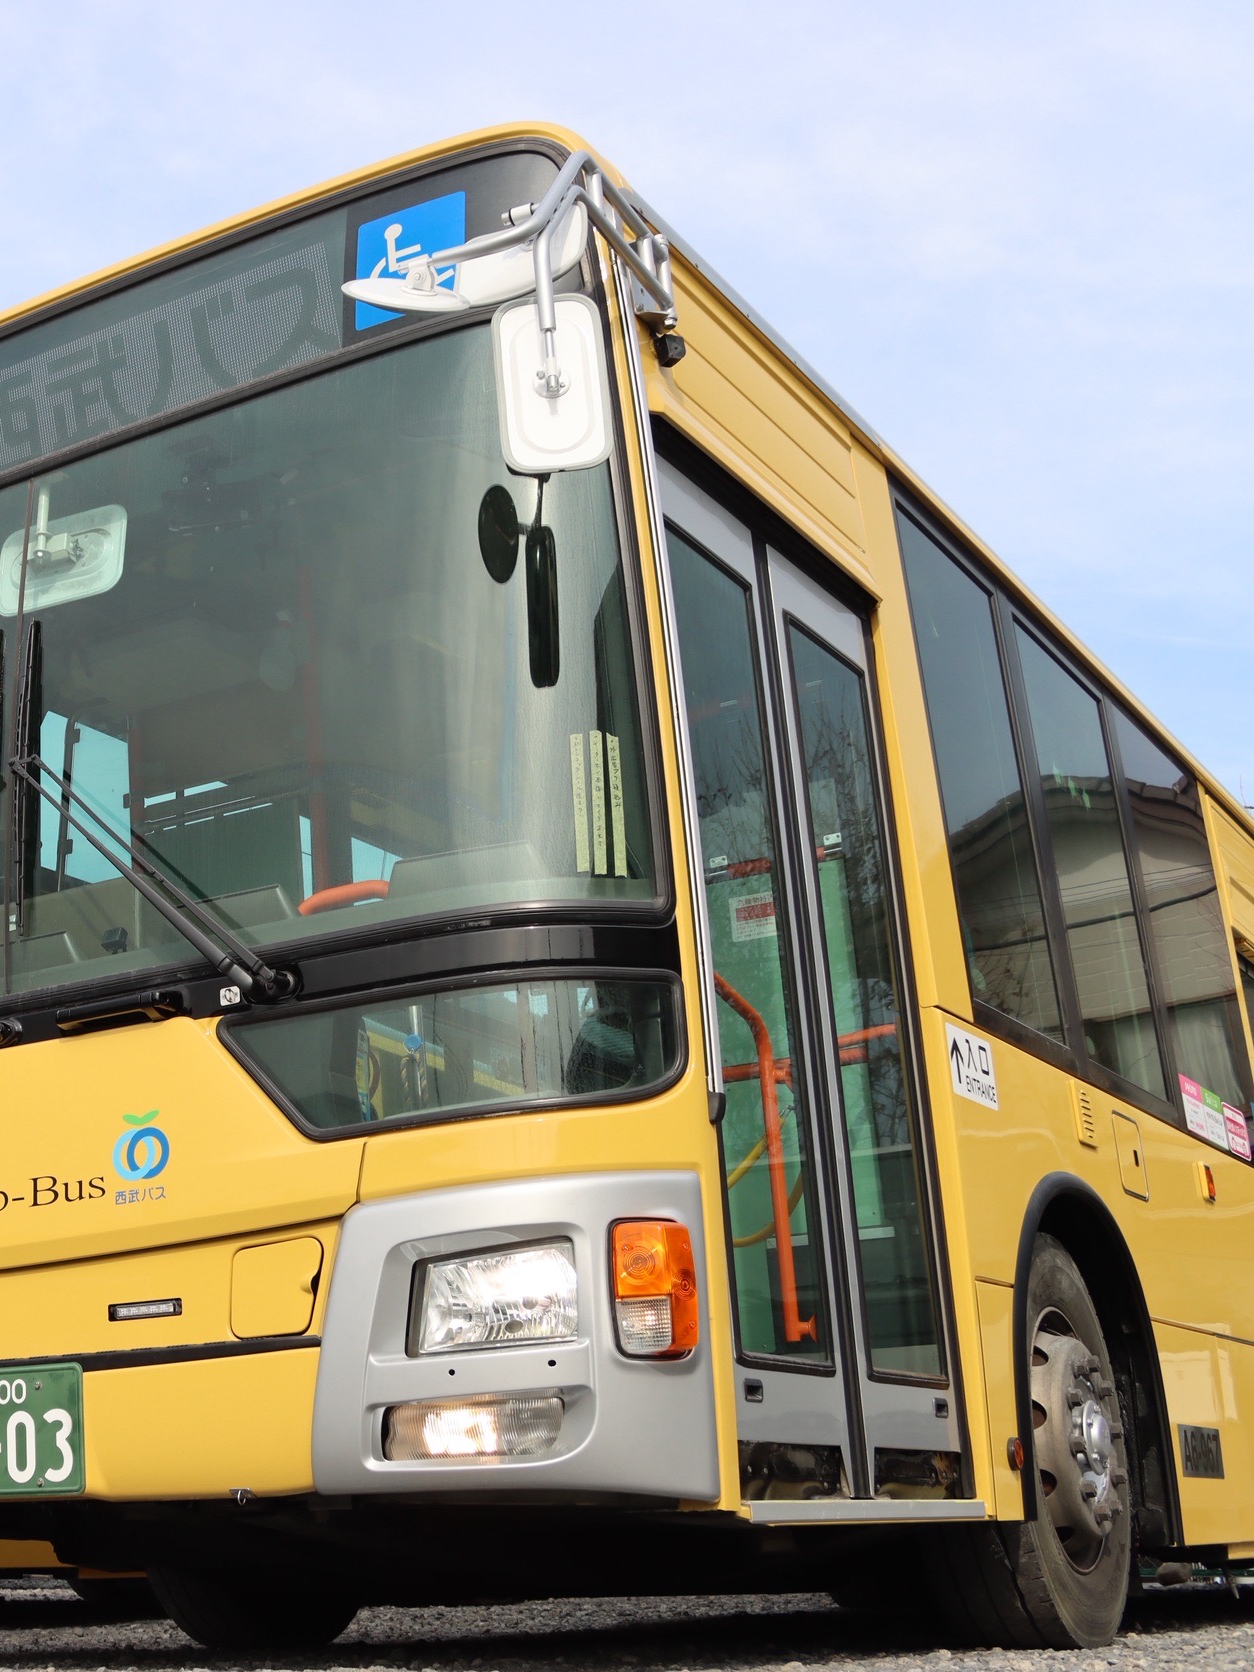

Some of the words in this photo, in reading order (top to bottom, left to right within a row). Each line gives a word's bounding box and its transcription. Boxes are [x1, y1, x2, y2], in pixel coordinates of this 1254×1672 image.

[964, 1038, 990, 1076] 入口
[965, 1075, 997, 1104] ENTRANCE
[114, 1186, 167, 1206] 西武バス
